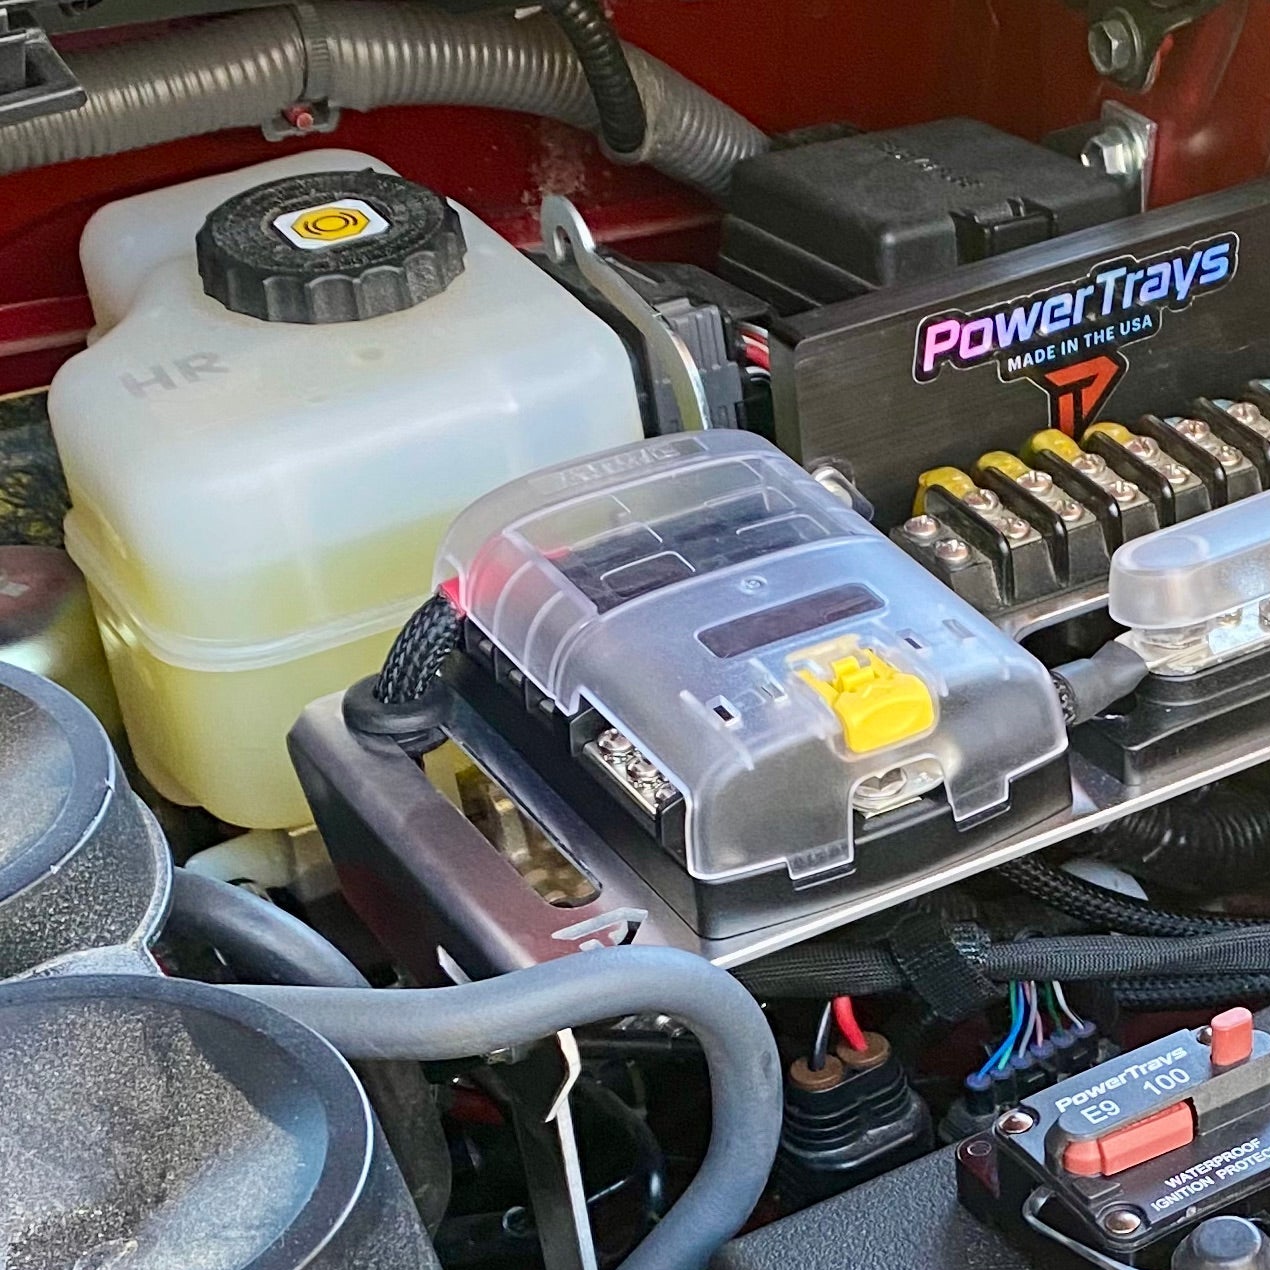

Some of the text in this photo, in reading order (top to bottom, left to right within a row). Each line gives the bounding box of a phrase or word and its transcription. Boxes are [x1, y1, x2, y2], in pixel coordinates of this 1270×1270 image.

[922, 242, 1231, 372] PowerTrays
[1007, 313, 1153, 373] MADE IN THE USA
[120, 351, 232, 399] HR
[1054, 1045, 1188, 1113] PowerTrays
[1081, 1068, 1191, 1126] E9 100
[1164, 1137, 1262, 1189] WATERPROOF
[1150, 1176, 1214, 1213] IGNITION
